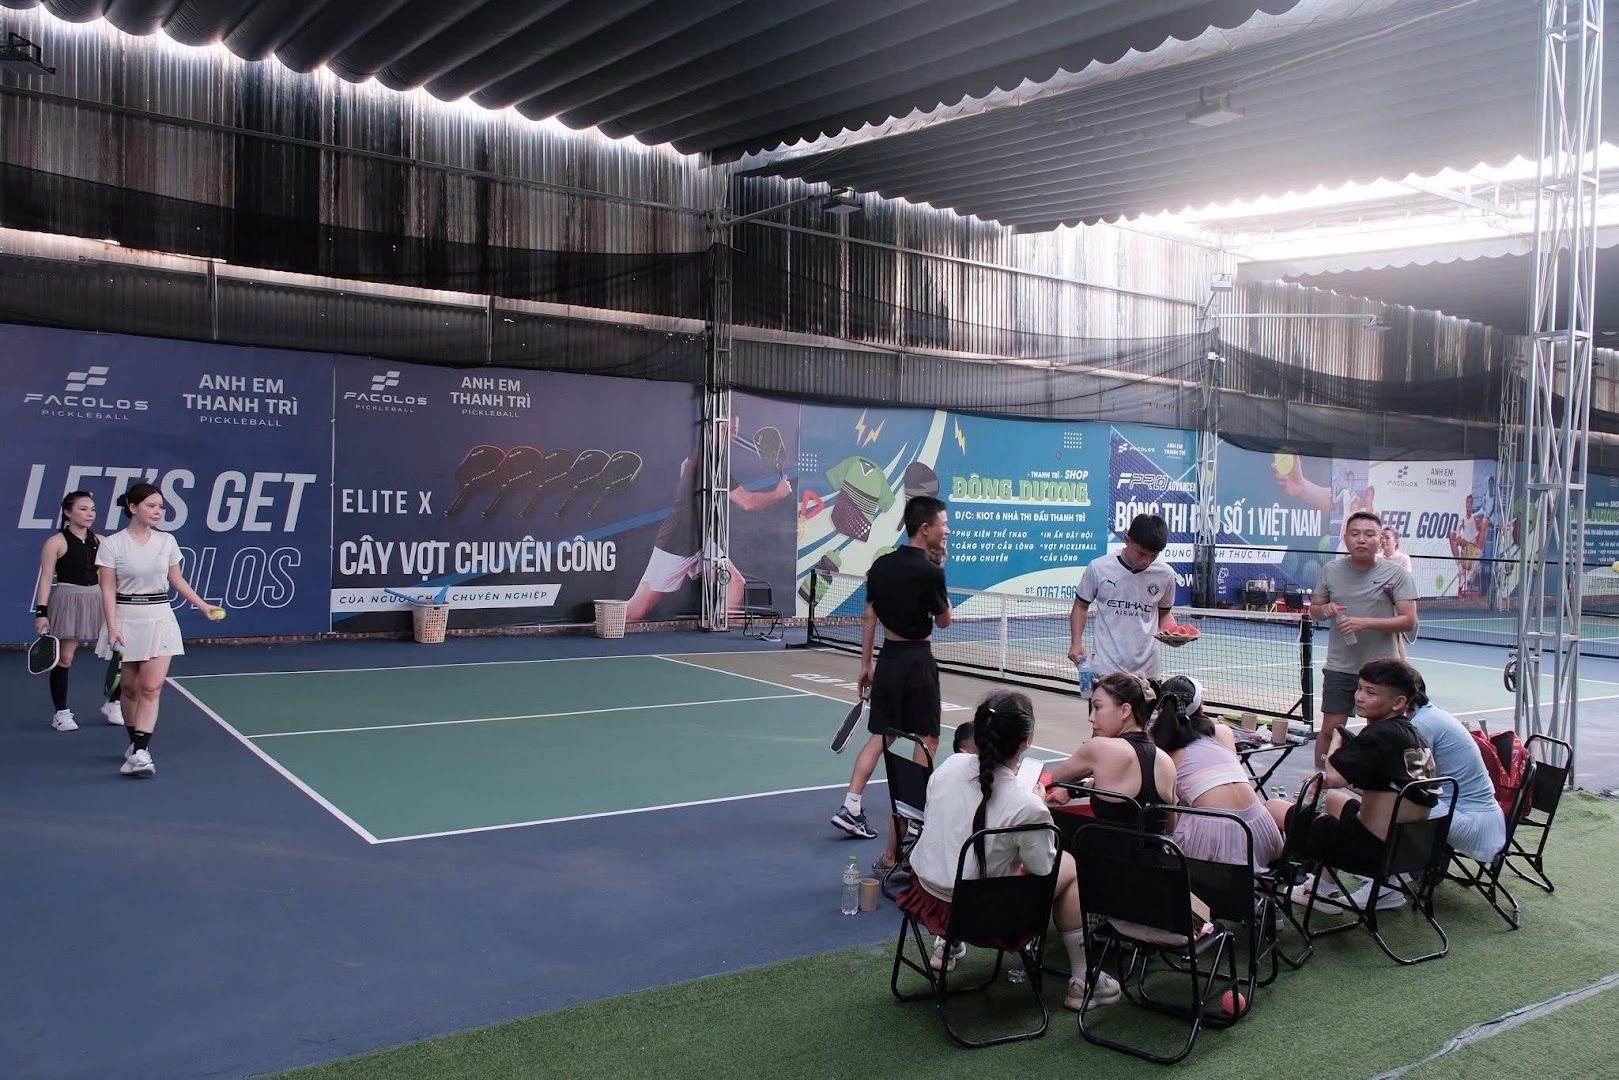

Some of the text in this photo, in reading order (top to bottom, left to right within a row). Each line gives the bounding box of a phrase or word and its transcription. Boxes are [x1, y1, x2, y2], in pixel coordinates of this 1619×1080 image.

[199, 374, 285, 394] ANH EM
[461, 376, 521, 392] ANH EM
[24, 393, 149, 411] FACOLOS
[183, 394, 299, 416] THANH TRÌ
[344, 392, 428, 406] FACOLOS
[450, 392, 531, 409] THANH TRÌ
[355, 404, 415, 413] PICKLEBALL
[462, 409, 519, 418] PICKLEBALL
[42, 410, 130, 421] PICKLEBALL
[200, 416, 282, 427] PICKLEBALL
[1064, 470, 1089, 480] SHOP
[1431, 468, 1454, 477] ANH EM
[952, 472, 1089, 503] ĐÔNG DƯƠNG
[1426, 478, 1447, 487] THANH
[206, 470, 317, 532] GET
[342, 488, 433, 515] ELITE X
[955, 510, 1086, 522] Đ/C: KIOT 6 NHÀ THI ĐẤU THANH TRÌ
[1162, 503, 1188, 533] THI
[1189, 496, 1220, 534] ĐU
[1223, 498, 1246, 535] SỐ
[1247, 507, 1255, 536] 1
[1258, 502, 1289, 542] VIỆT
[1290, 508, 1322, 537] NAM
[1380, 510, 1460, 539] FEEL GOOD
[1015, 542, 1034, 550] LÔNG
[1059, 543, 1097, 551] PICKLEBALL
[339, 534, 617, 581] CÂY VỢT CHUYÊN CÔNG
[955, 554, 977, 562] BÓNG
[1059, 554, 1078, 562] LÔNG
[339, 594, 364, 604] CỦA
[452, 592, 500, 602] CHUYÊN
[505, 591, 548, 601] NGHIỆP
